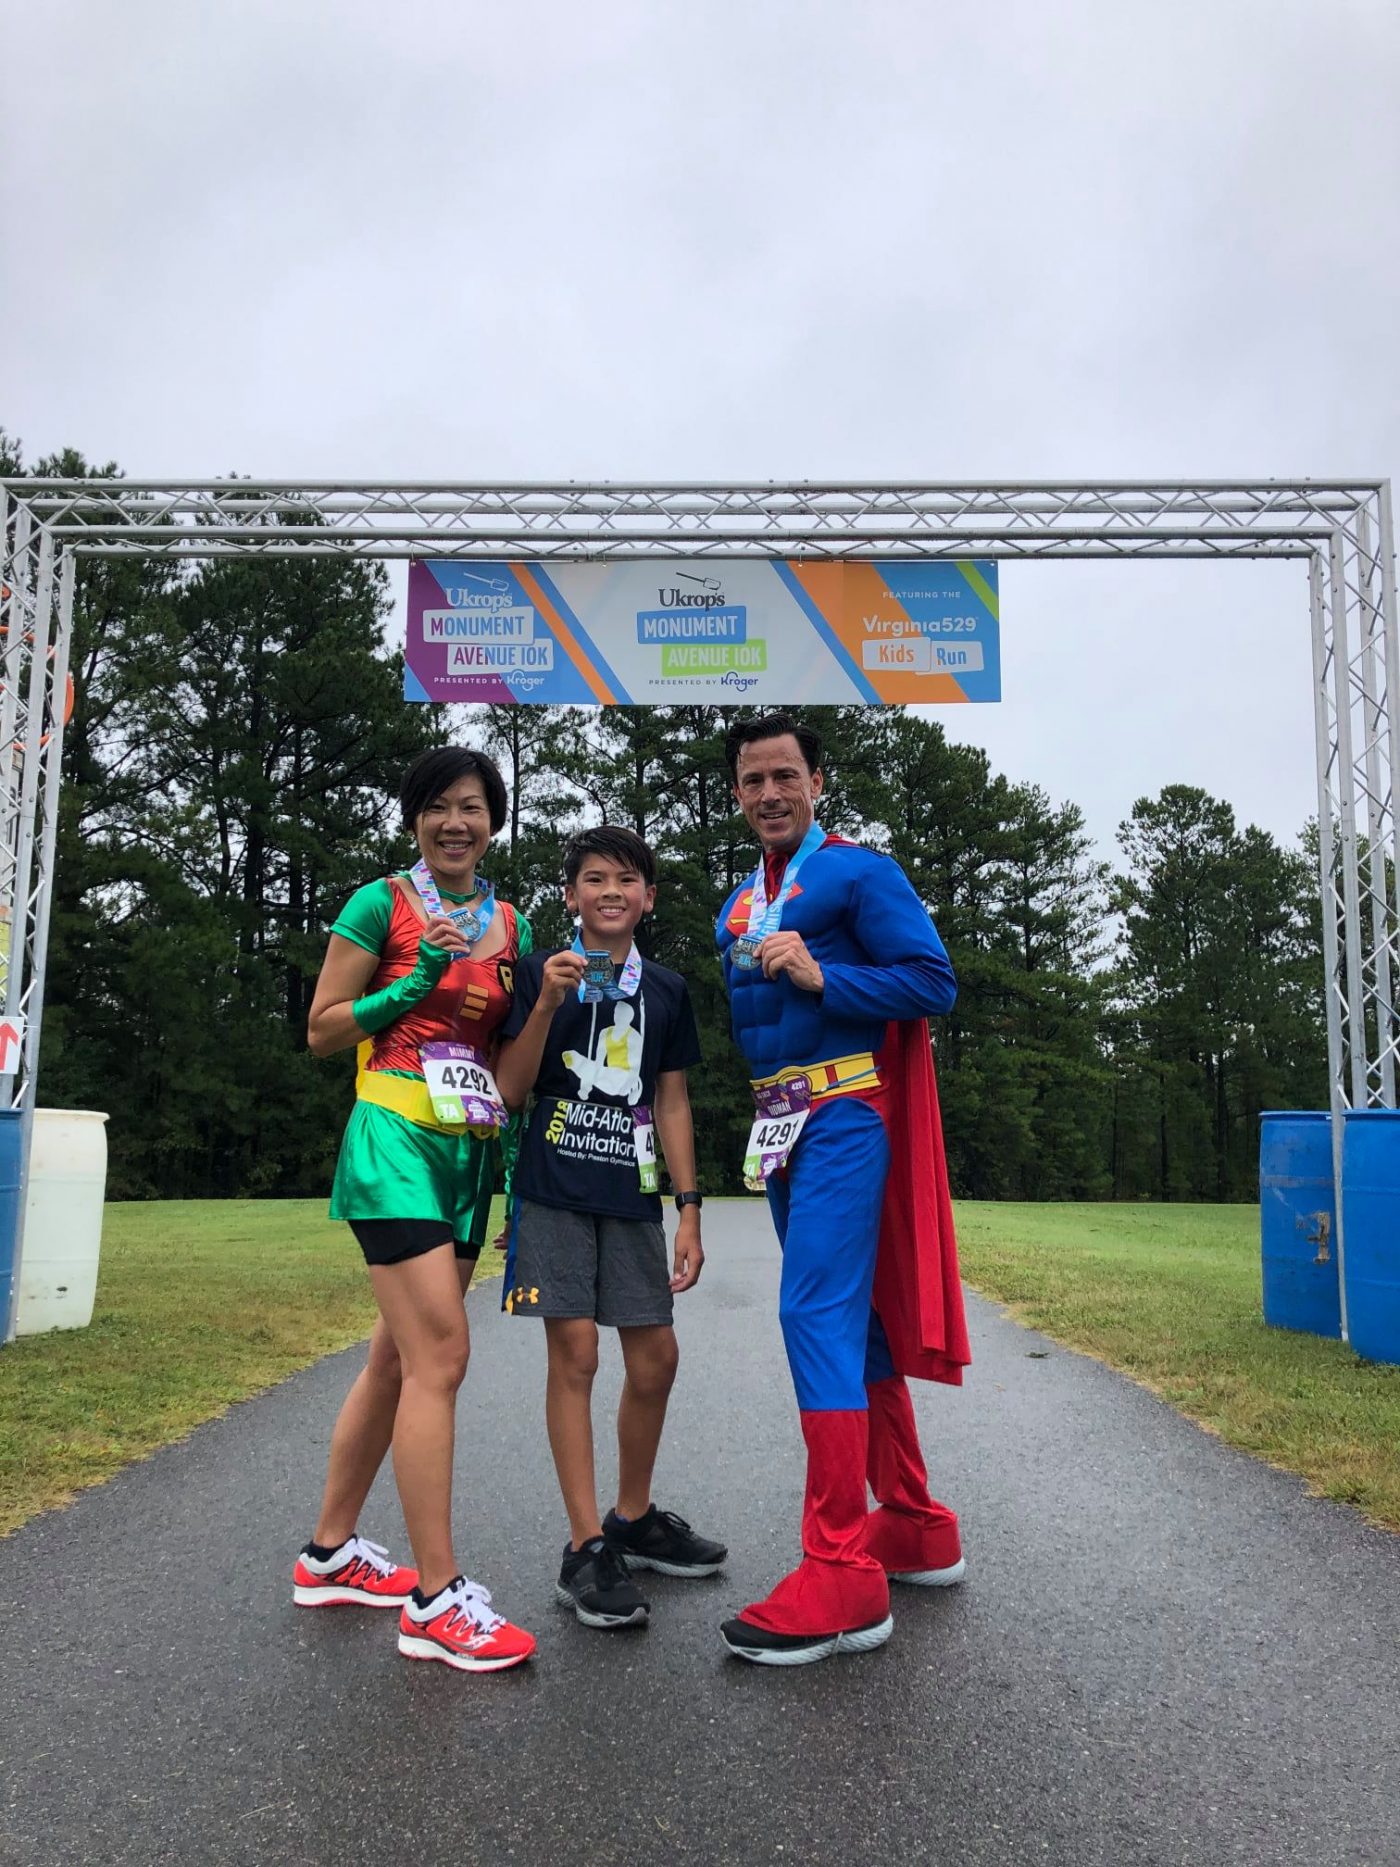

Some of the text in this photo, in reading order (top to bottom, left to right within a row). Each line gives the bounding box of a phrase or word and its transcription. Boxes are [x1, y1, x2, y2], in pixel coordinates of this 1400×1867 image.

[445, 588, 512, 613] Ukrop's
[658, 589, 725, 611] Ukrop's
[883, 591, 938, 599] FEATURING
[431, 616, 525, 636] MONUMENT
[644, 616, 738, 638] MONUMENT
[863, 615, 977, 637] Virginia529
[453, 647, 548, 666] AVENUE 10K
[667, 647, 761, 667] AVENUE 10K
[879, 644, 914, 663] Kids
[937, 648, 967, 665] Run
[433, 677, 487, 685] PRESENTED
[507, 669, 545, 691] Kroger
[721, 671, 759, 692] Kroger
[441, 1066, 492, 1096] 4292
[545, 1100, 568, 1145] 2018
[565, 1102, 632, 1134] Mid-Atla
[756, 1119, 799, 1148] 4291
[557, 1147, 577, 1158] Hosted
